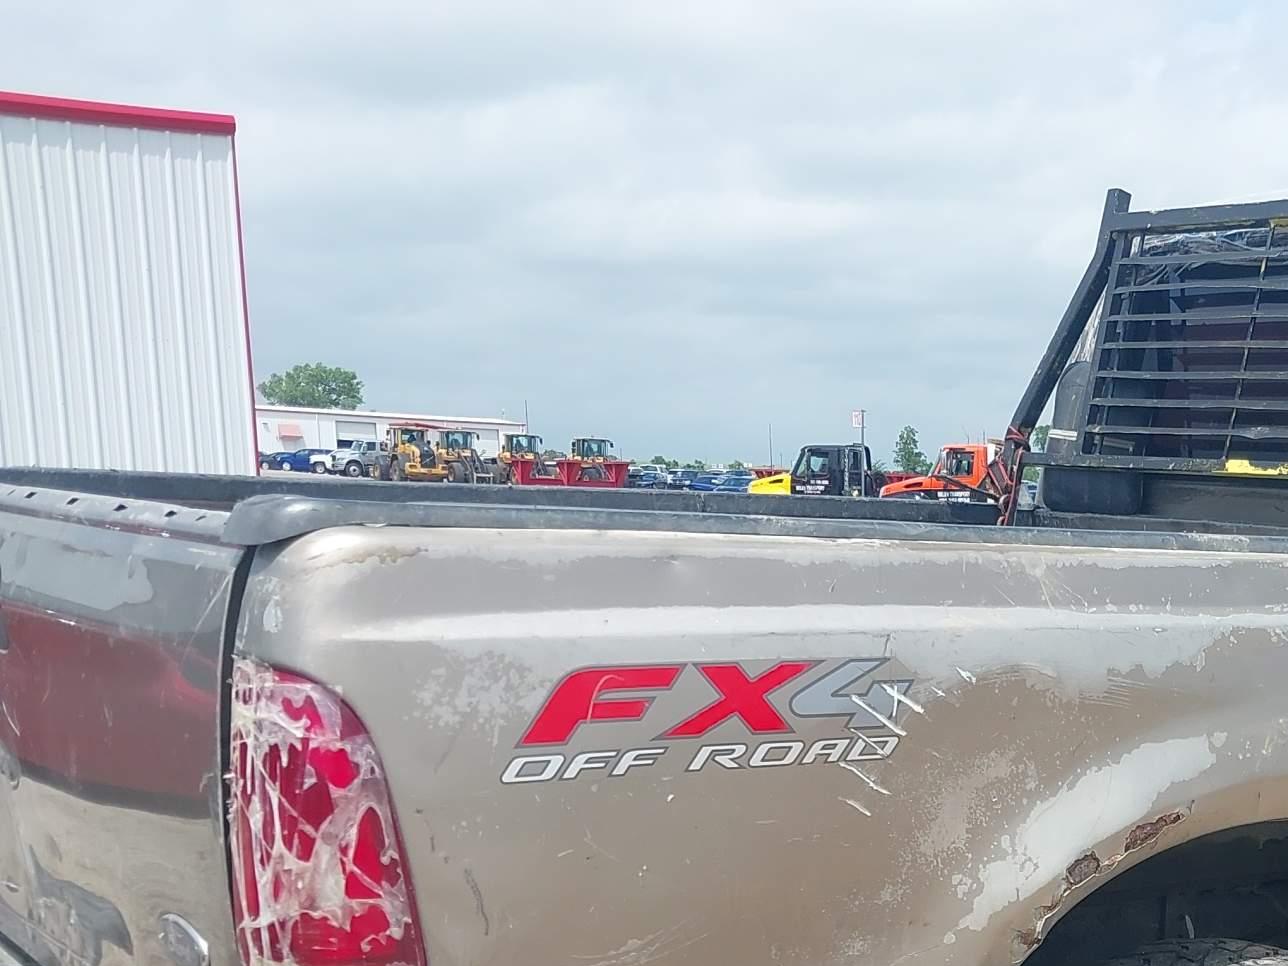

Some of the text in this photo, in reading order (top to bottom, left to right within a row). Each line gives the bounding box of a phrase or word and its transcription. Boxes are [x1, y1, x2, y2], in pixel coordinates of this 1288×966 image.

[514, 657, 911, 748] FX4
[500, 735, 901, 784] OFF ROAD
